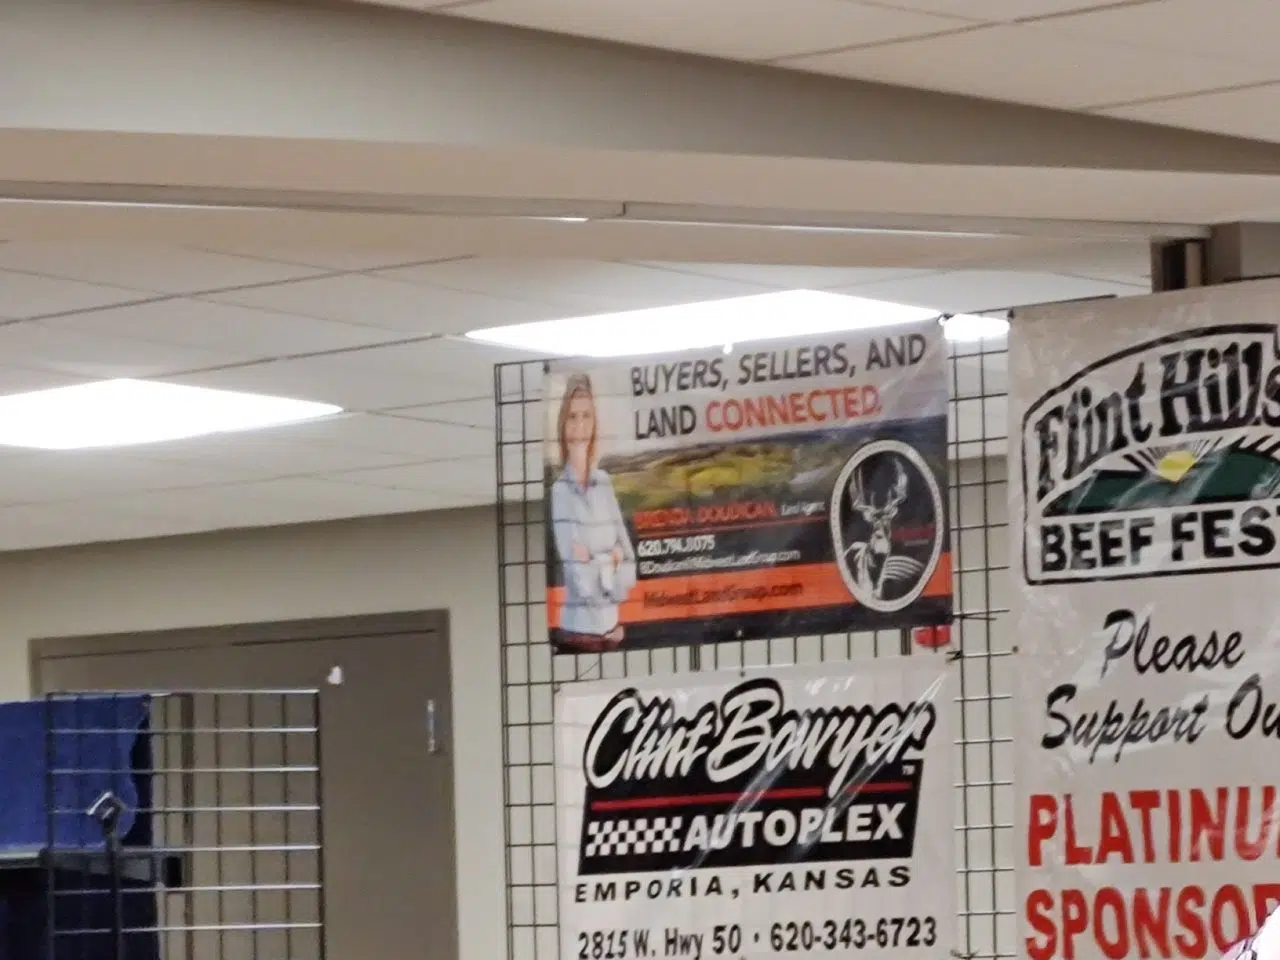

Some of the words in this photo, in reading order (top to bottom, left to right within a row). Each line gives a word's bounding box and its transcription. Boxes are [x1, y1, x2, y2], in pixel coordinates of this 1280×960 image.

[631, 358, 729, 396] BUYERS,
[738, 343, 856, 385] SELLERS,
[866, 334, 926, 370] AND
[634, 405, 697, 440] LAND
[1035, 362, 1152, 503] Flint
[1040, 516, 1155, 572] BEEF
[1100, 608, 1246, 678] Please
[584, 688, 718, 788] Clint
[706, 678, 936, 797] Bowyer
[1041, 683, 1210, 765] Support
[683, 803, 907, 851] AUTOPLEX
[575, 876, 741, 903] EMPORIA,
[753, 866, 912, 893] KANSAS
[578, 929, 628, 960] 2815
[633, 929, 656, 958] W.
[712, 924, 741, 954] 50
[770, 916, 937, 951] 620-343-6723
